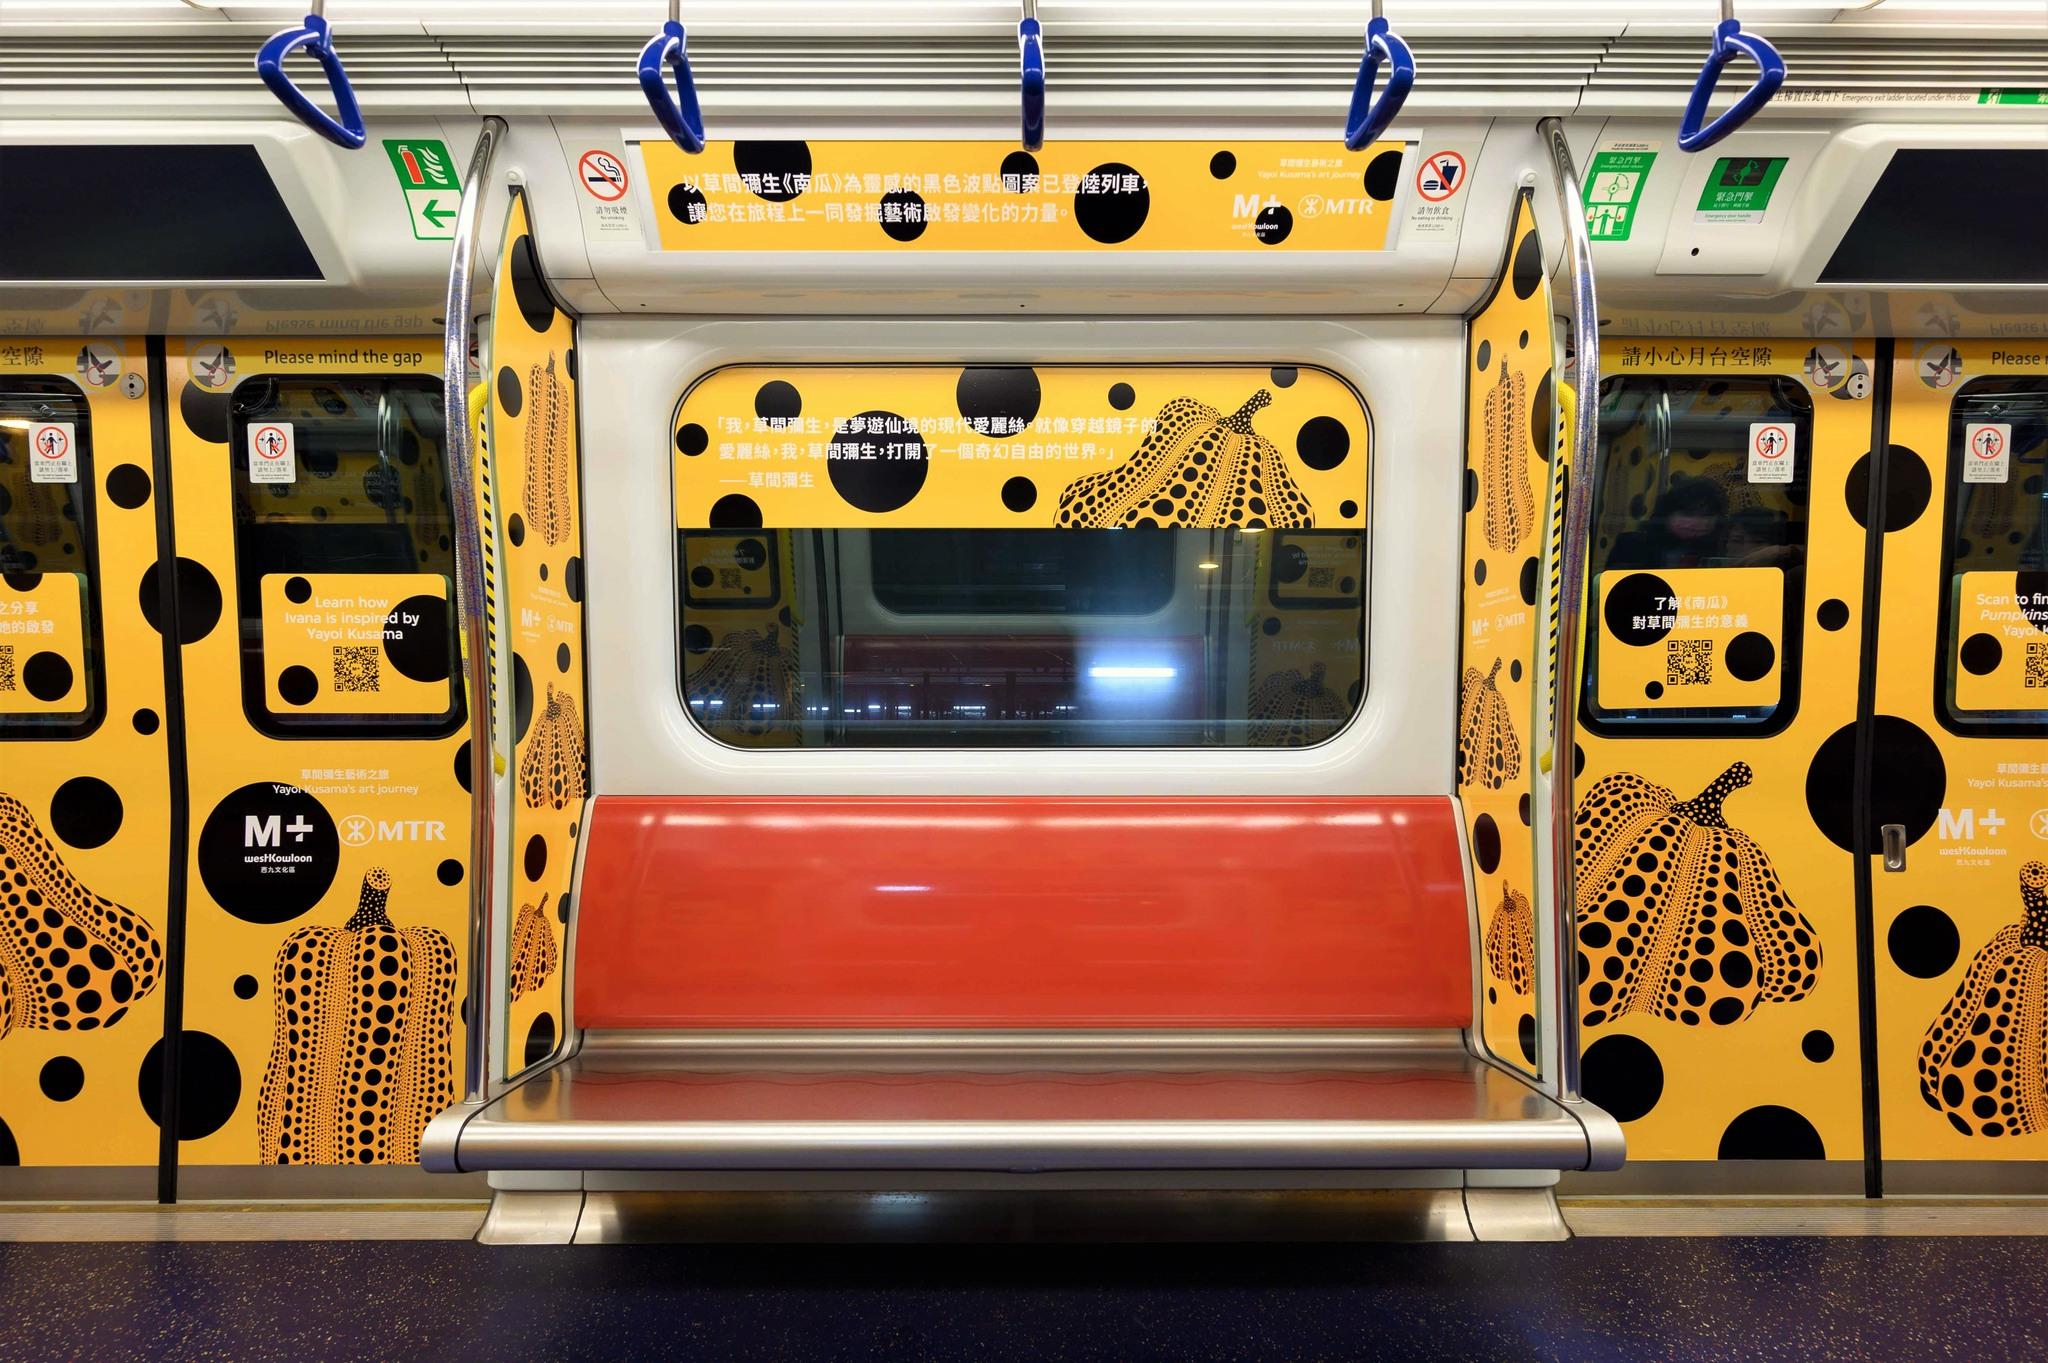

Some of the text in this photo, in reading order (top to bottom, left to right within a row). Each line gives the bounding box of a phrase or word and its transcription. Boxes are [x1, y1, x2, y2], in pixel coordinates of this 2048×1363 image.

[1232, 193, 1281, 218] M+
[1325, 198, 1374, 215] MTR
[1, 346, 44, 366] 空隙
[264, 349, 422, 366] Please mind the gap
[1622, 346, 1773, 366] 請小心月台空隙
[1992, 350, 2041, 365] Please
[315, 596, 389, 609] Learn how
[1654, 596, 1729, 611] 了解《南瓜》
[1976, 593, 2009, 605] Scan
[2014, 593, 2029, 605] to
[284, 612, 420, 626] Ivana is inspired by
[1632, 614, 1749, 630] 對草間彌生的意義
[1980, 608, 2048, 622] Pumpkins
[306, 628, 403, 642] Yayoi Kusama
[2003, 625, 2038, 638] Yayoi
[272, 784, 419, 796] Yayoi Kusama's art journey
[1967, 778, 1995, 789] Yayoi
[244, 815, 313, 847] M+
[378, 820, 446, 841] MTR
[1938, 808, 2006, 840] M+
[260, 866, 296, 874] 西九文化區
